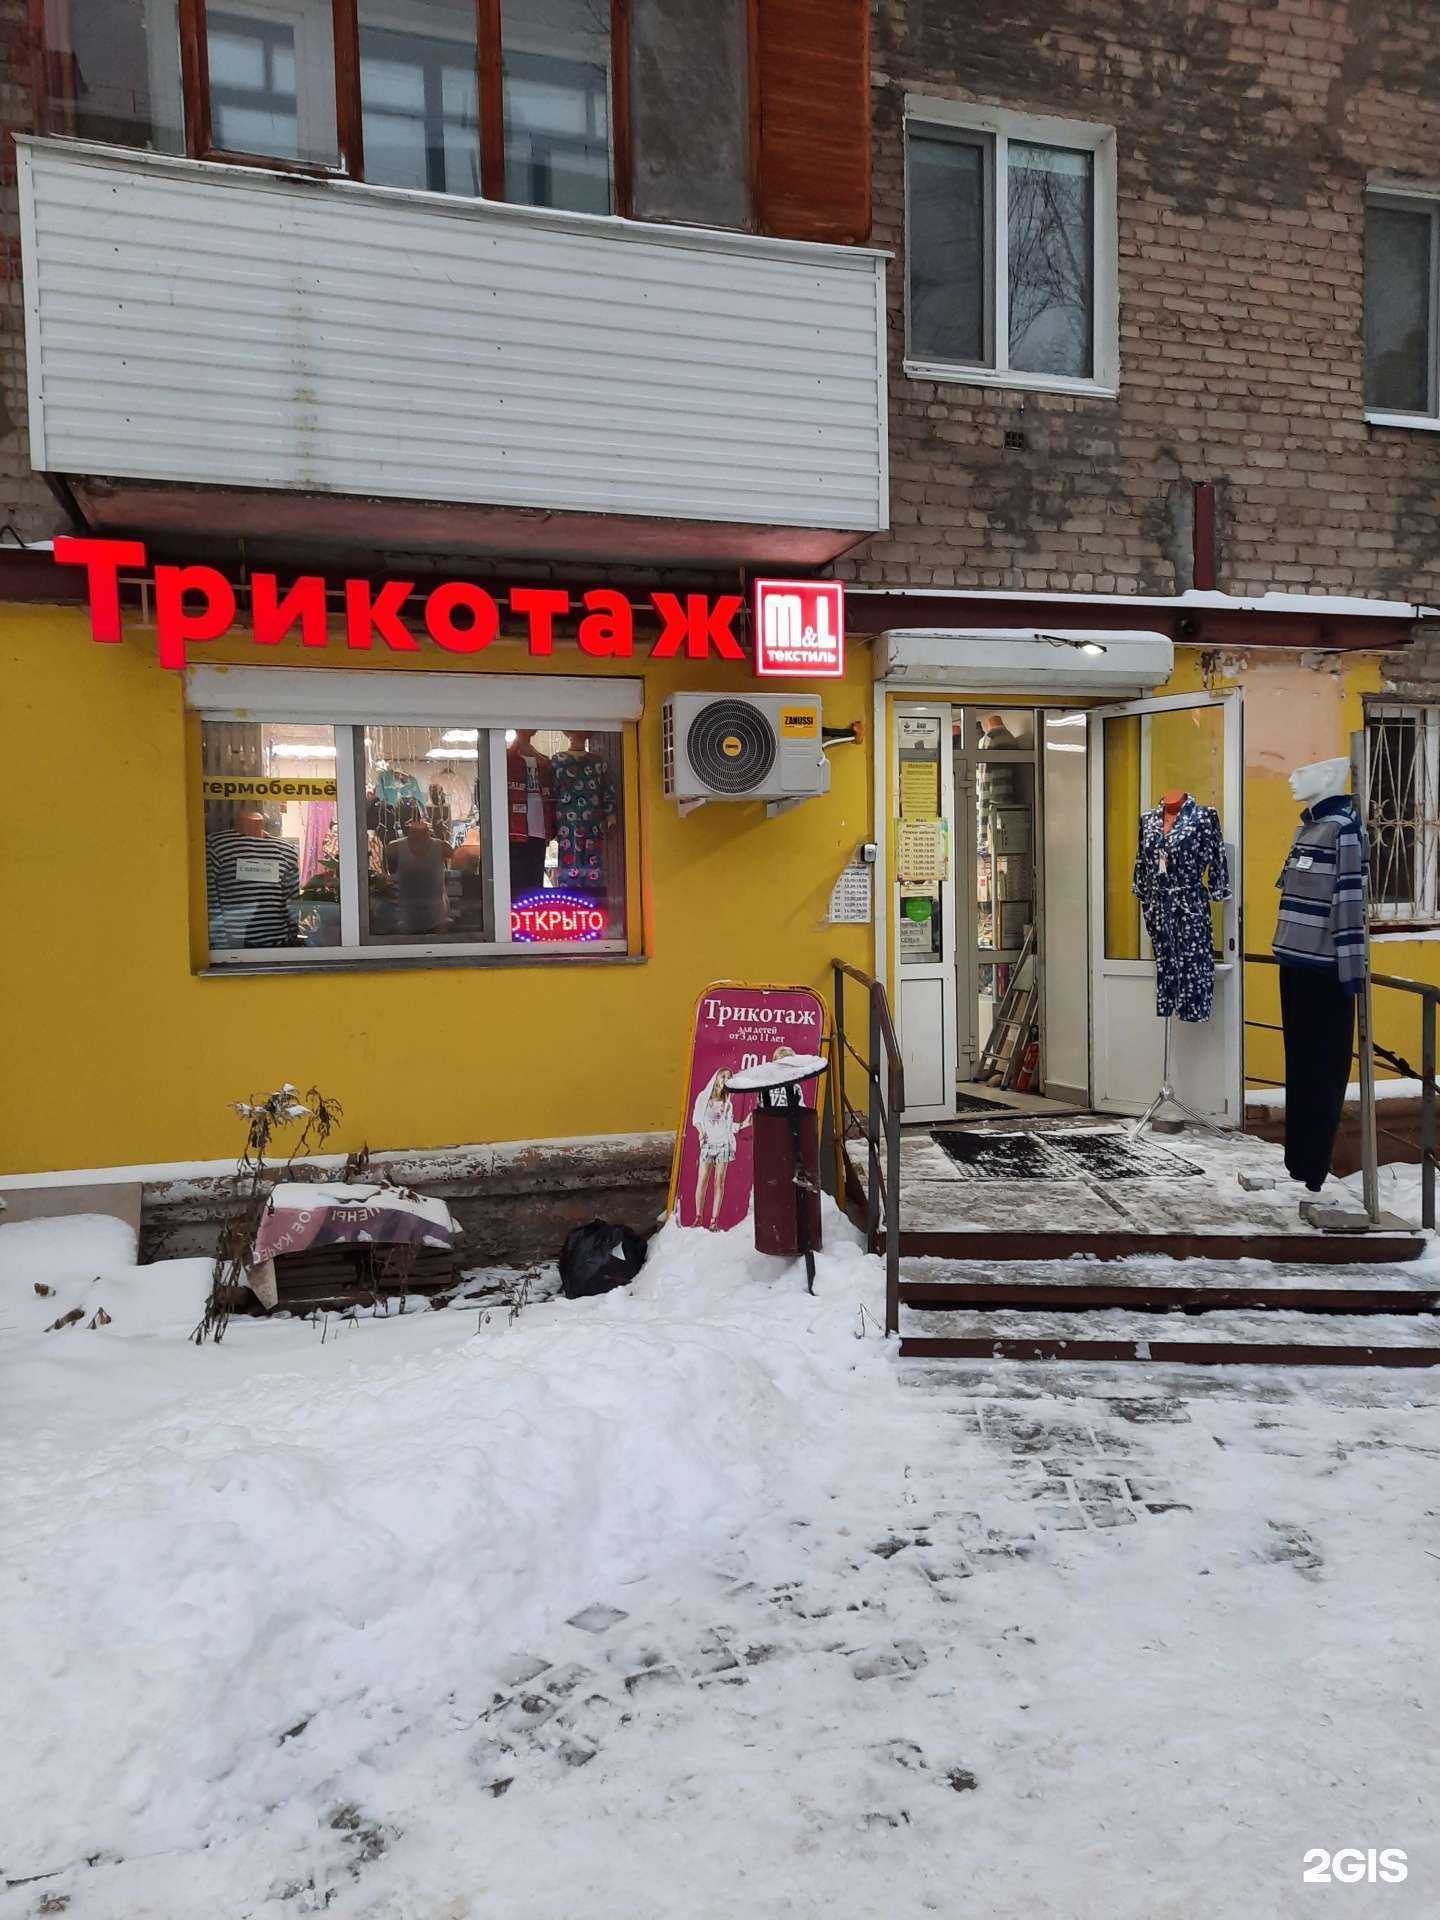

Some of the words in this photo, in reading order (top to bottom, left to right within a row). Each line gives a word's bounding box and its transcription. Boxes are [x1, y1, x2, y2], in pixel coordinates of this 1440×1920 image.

[53, 535, 746, 671] Трикотаж
[784, 716, 813, 726] ZANUSSI
[203, 779, 337, 798] термобельё
[509, 911, 603, 931] ОТКРЫТО
[704, 999, 816, 1027] Трикотаж
[738, 1026, 752, 1034] для
[753, 1026, 777, 1034] детей
[740, 1031, 746, 1040] 3
[747, 1034, 758, 1042] до
[760, 1033, 769, 1042] 11
